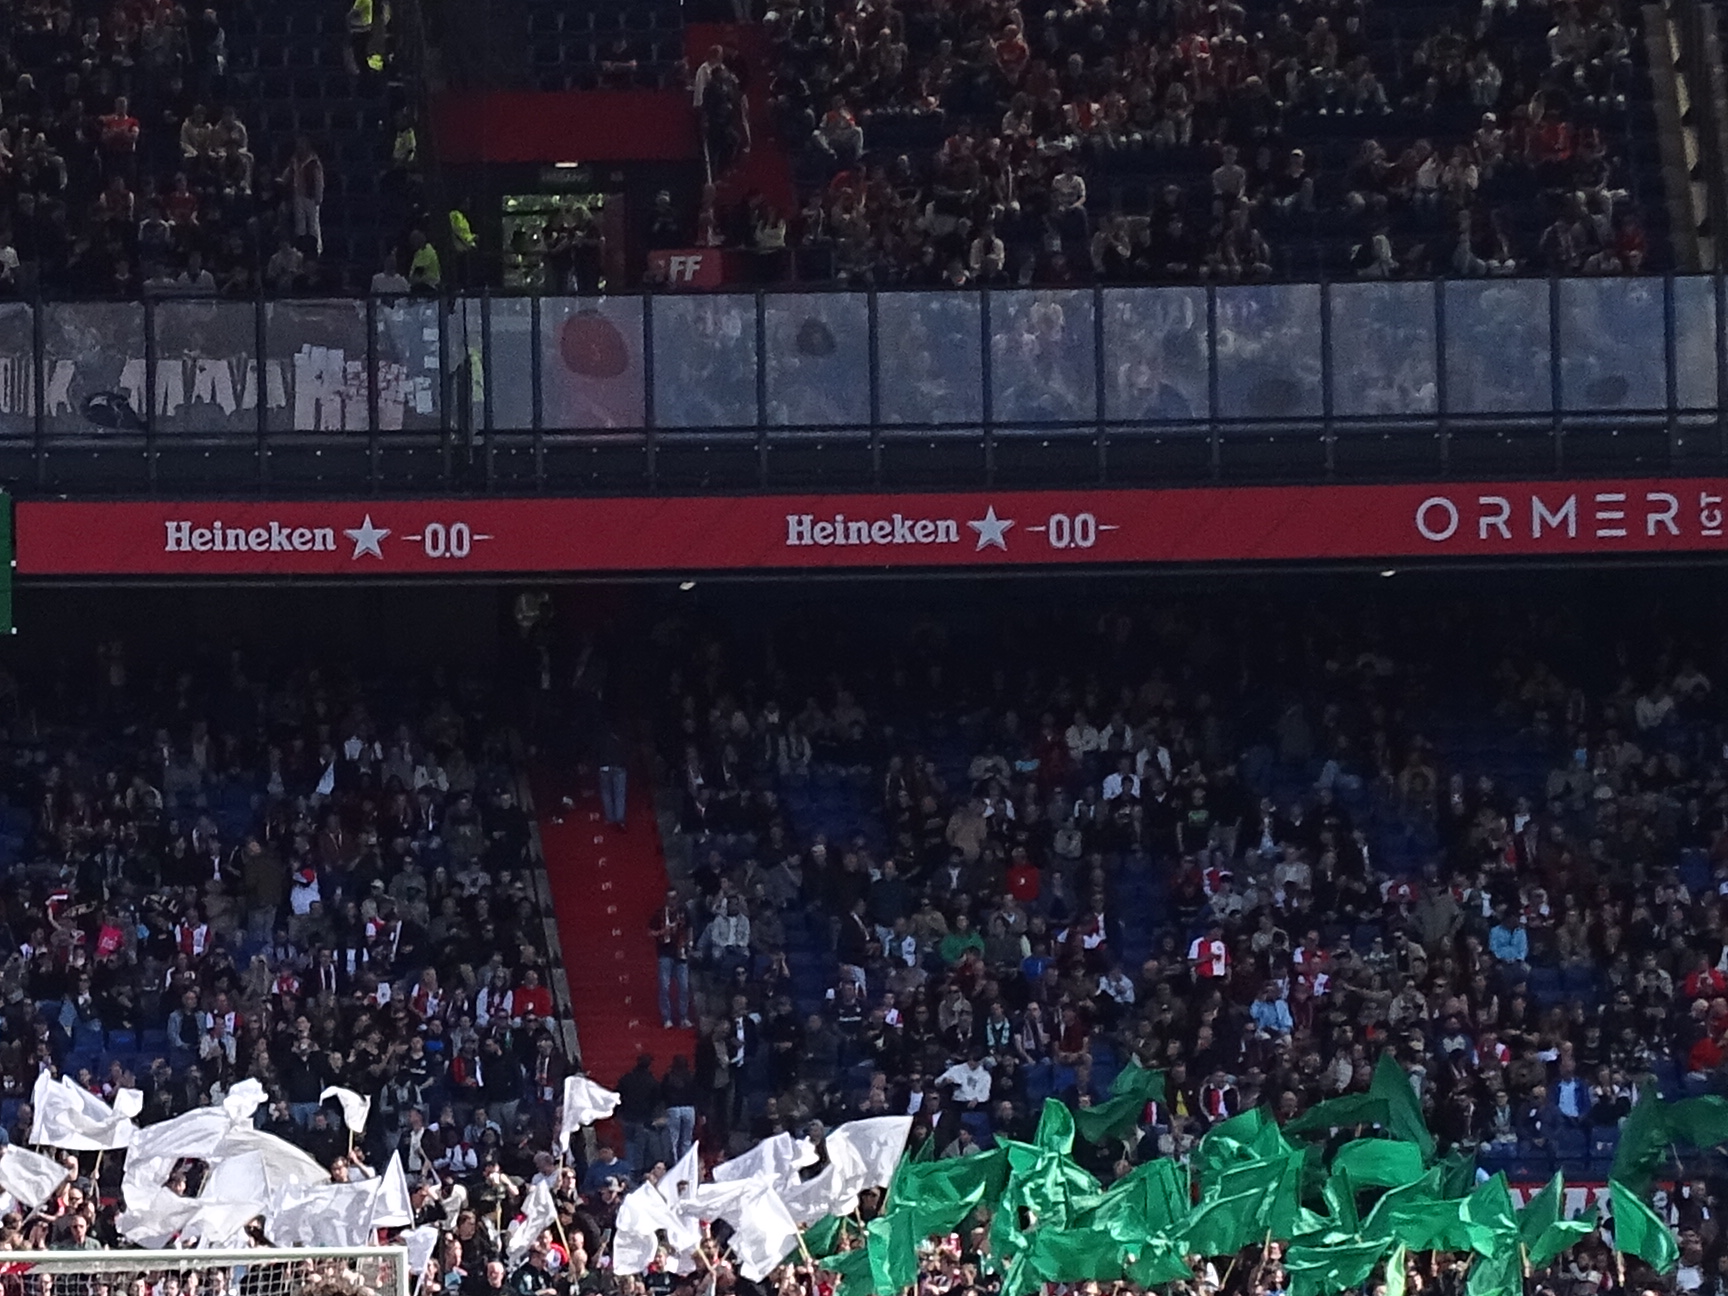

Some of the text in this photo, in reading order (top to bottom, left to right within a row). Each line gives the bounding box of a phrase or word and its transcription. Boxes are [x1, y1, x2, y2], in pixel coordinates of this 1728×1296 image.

[669, 255, 703, 281] FF
[786, 514, 960, 546] Heineken
[1416, 493, 1681, 542] ORMER
[165, 521, 337, 553] Heineken
